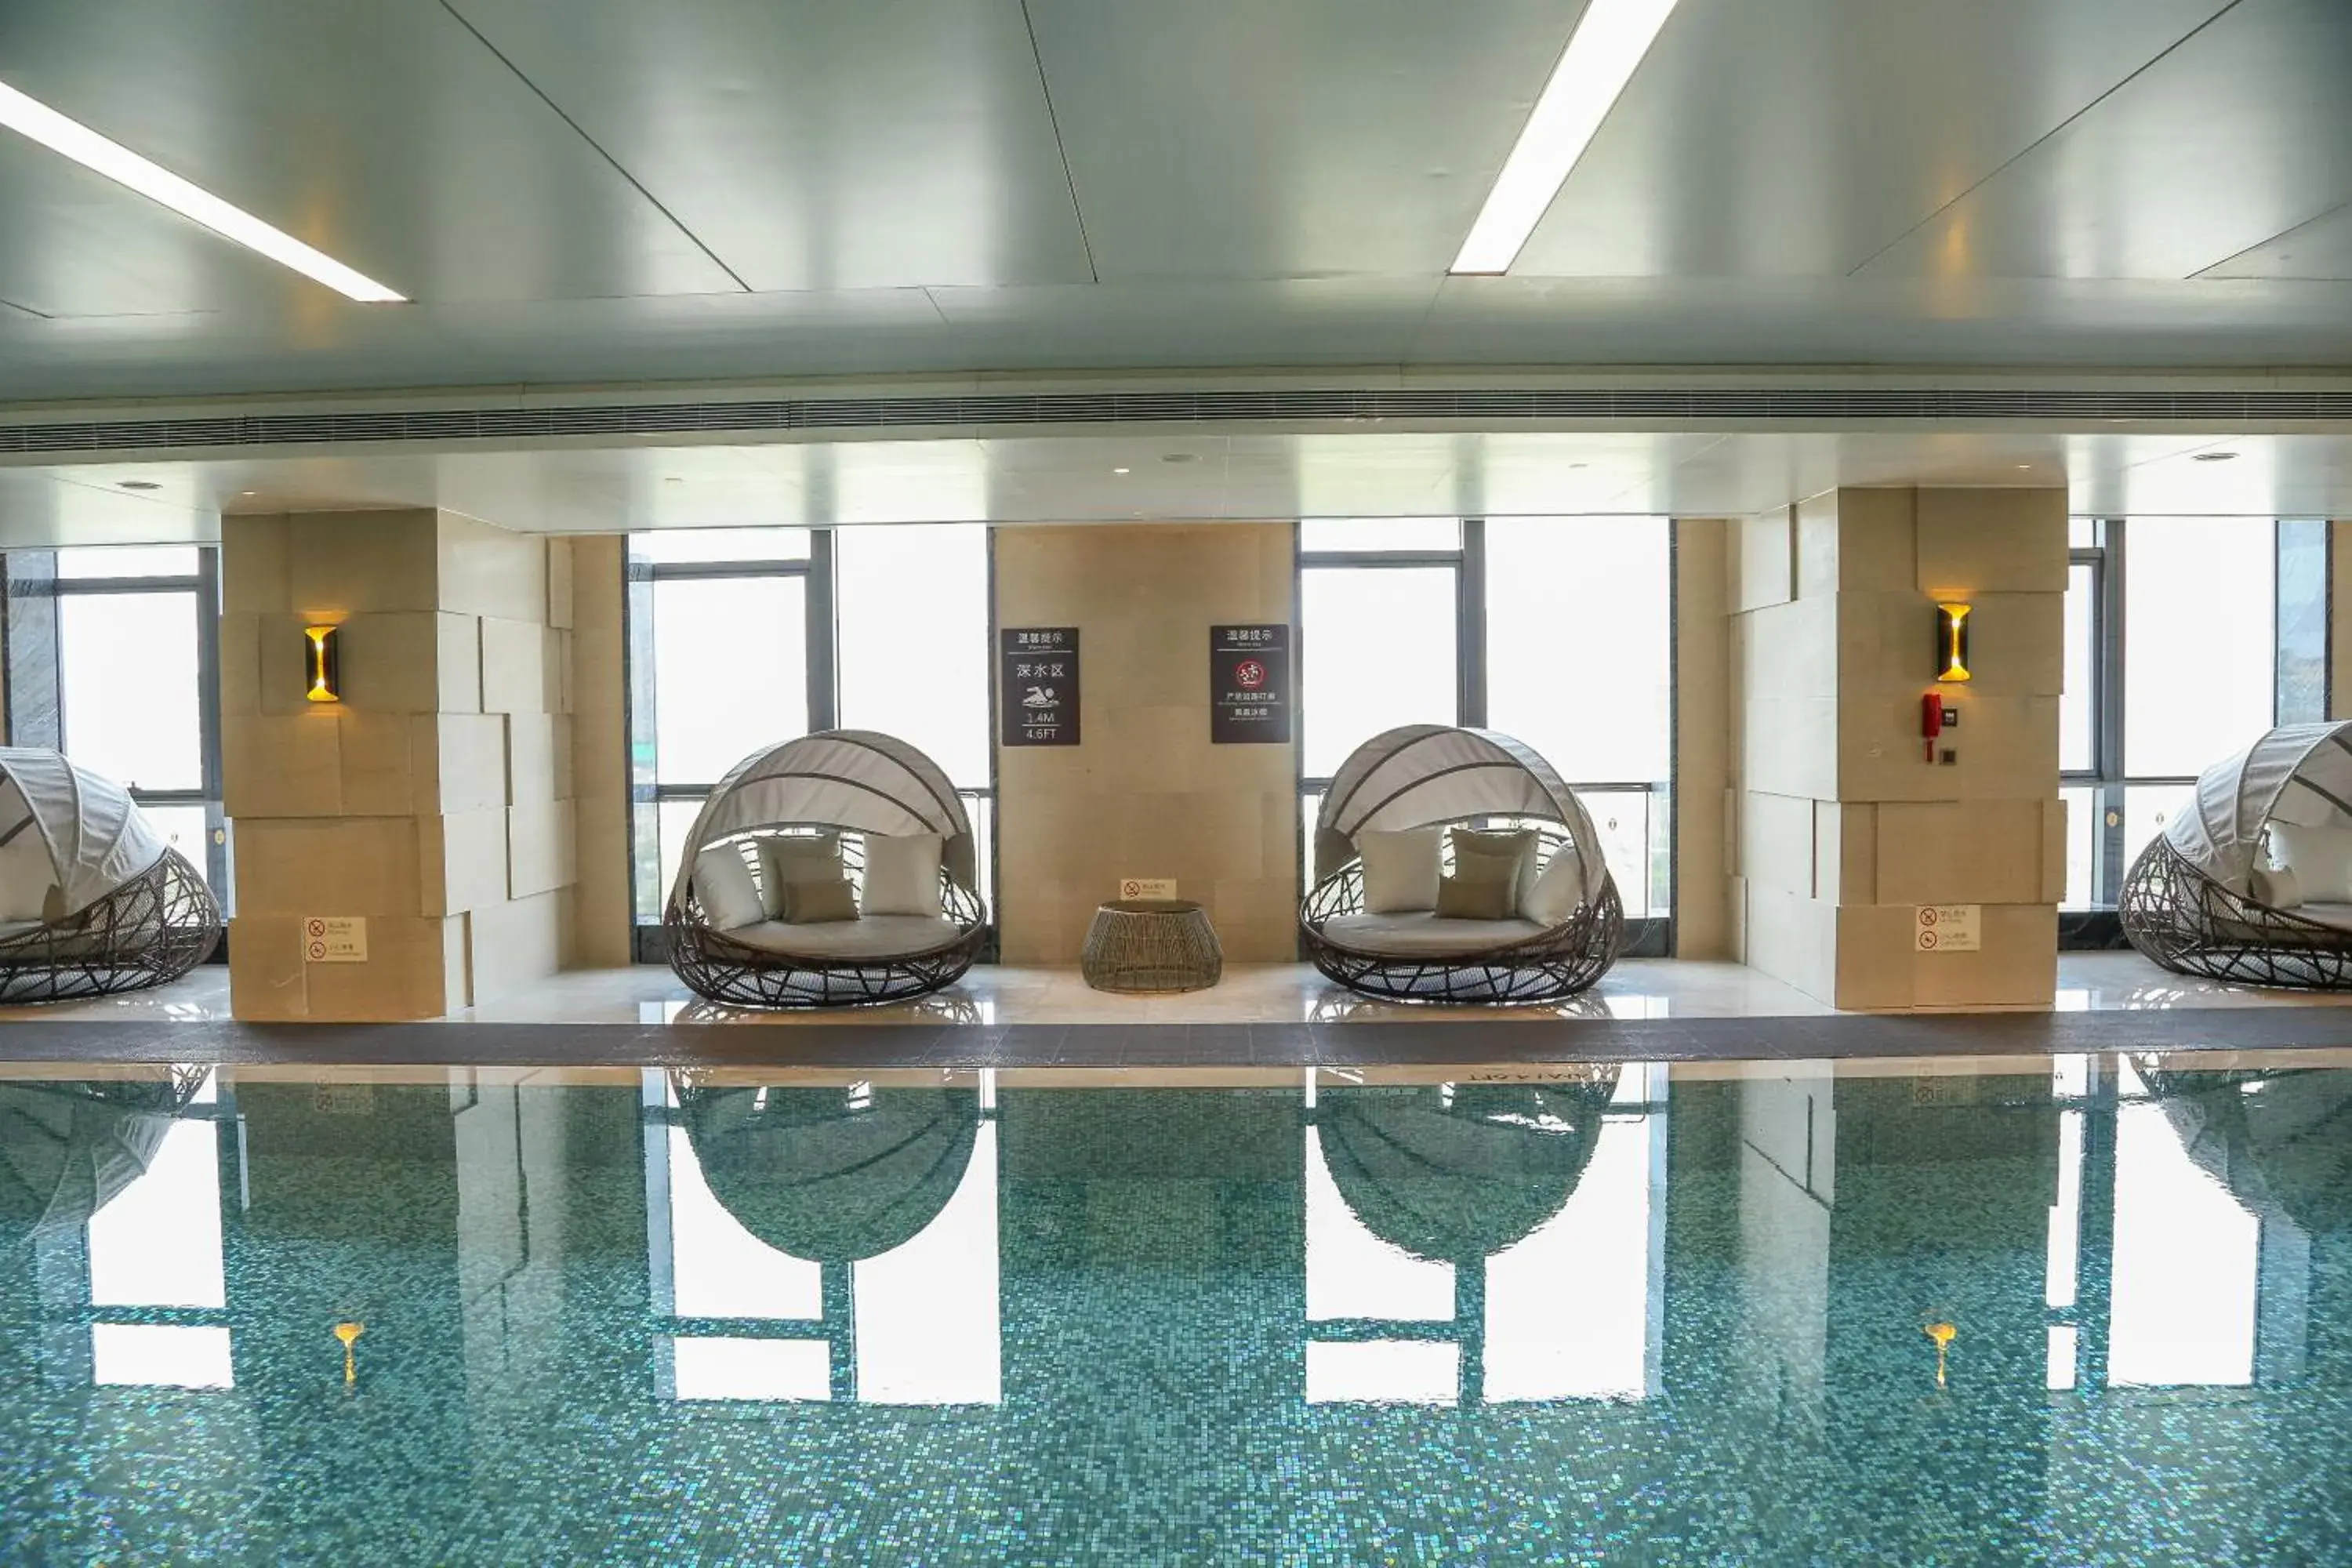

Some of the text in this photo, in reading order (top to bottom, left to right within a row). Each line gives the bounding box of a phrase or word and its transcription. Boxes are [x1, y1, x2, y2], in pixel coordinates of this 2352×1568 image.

[1017, 632, 1063, 644] 温馨提示
[1227, 630, 1272, 641] 温馨提示
[1016, 663, 1064, 677] 深水区
[1027, 713, 1054, 723] 1.4M
[1026, 728, 1057, 739] 4.6FT
